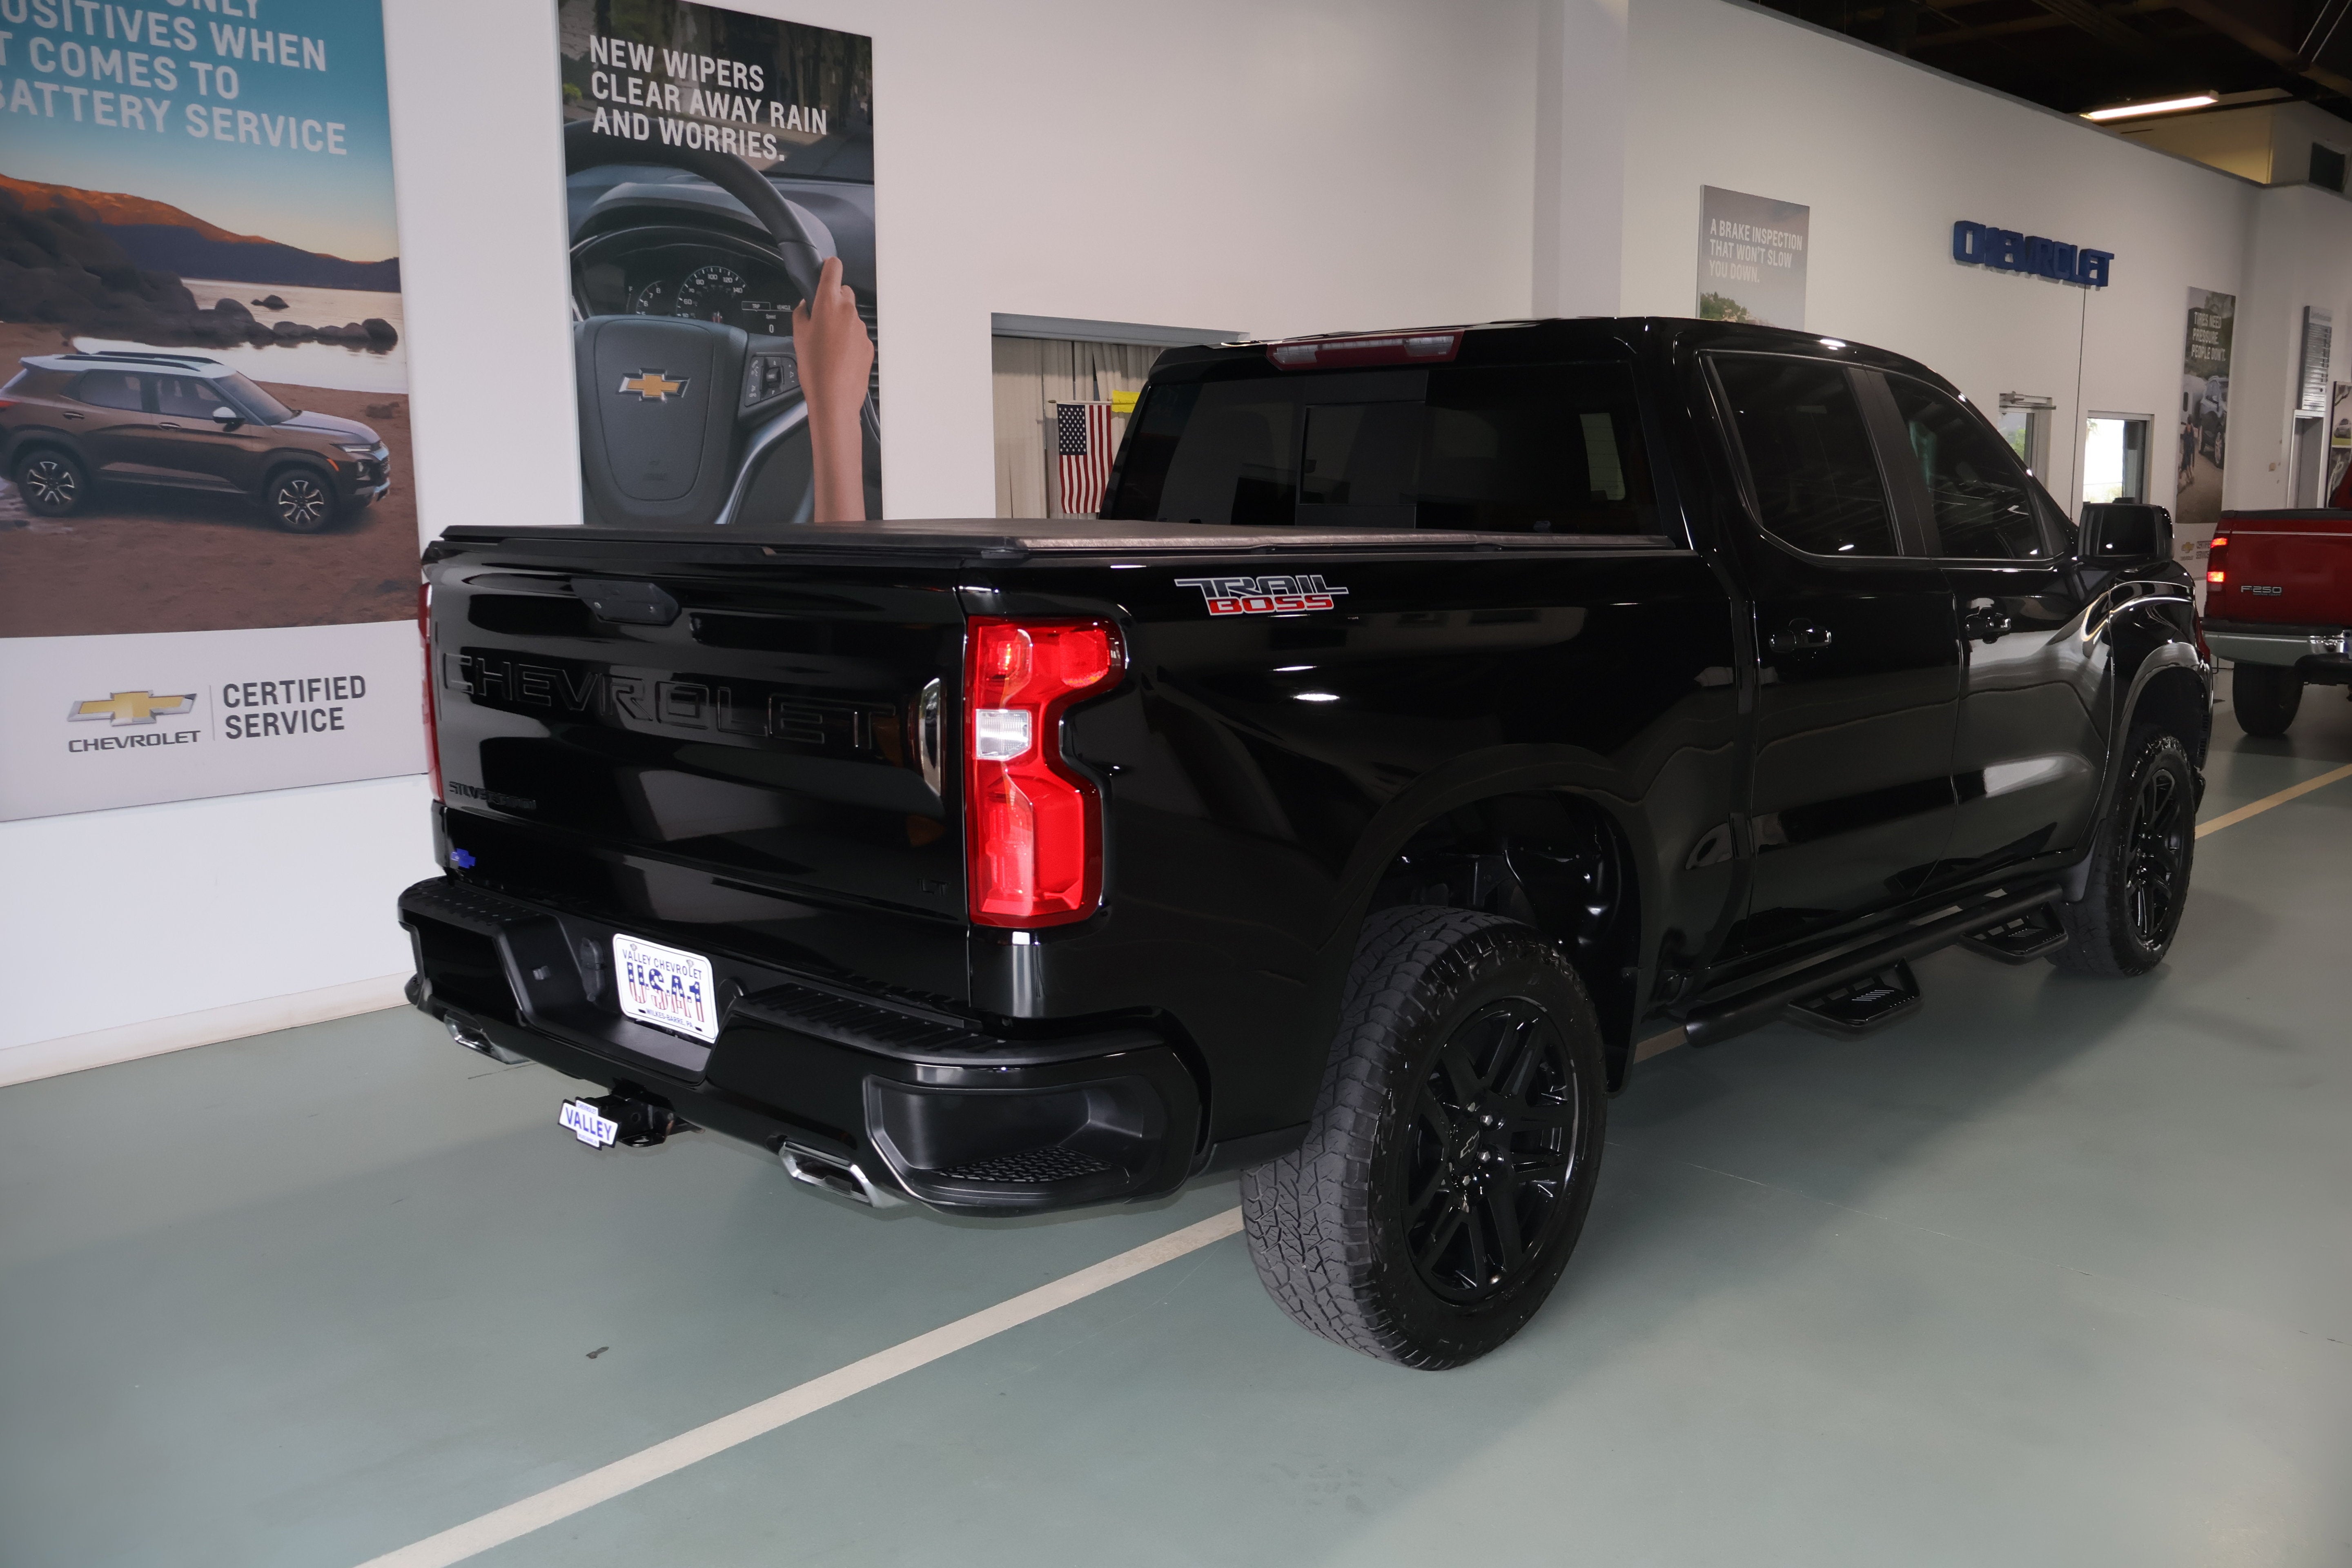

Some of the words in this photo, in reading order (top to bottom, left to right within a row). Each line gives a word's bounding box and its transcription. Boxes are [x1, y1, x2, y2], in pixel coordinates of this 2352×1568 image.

[0, 0, 197, 51] OSITIVES
[209, 22, 326, 71] WHEN
[0, 31, 13, 66] T
[29, 37, 178, 91] COMES
[189, 61, 238, 99] TO
[590, 35, 654, 73] NEW
[662, 49, 764, 92] WIPERS
[0, 78, 170, 132] ATTERY
[186, 104, 347, 155] SERVICE
[591, 71, 681, 113] CLEAR
[690, 89, 762, 124] AWAY
[770, 101, 827, 135] RAIN
[592, 107, 650, 140] AND
[659, 117, 785, 161] WORRIES.
[1710, 218, 1717, 235] A
[1719, 220, 1751, 242] BRAKE
[1752, 226, 1803, 251] INSPECTION
[1710, 239, 1734, 258] THAT
[1737, 244, 1766, 264] WON'T
[1767, 249, 1792, 268] SLOW
[1709, 260, 1728, 278] YOU
[1730, 263, 1760, 283] DOWN.
[1174, 575, 1349, 598] TRAIL
[1206, 594, 1334, 616] BOSS
[223, 675, 366, 708] CERTIFIED
[443, 653, 897, 750] CHEVROLET
[225, 707, 345, 740] SERVICE
[68, 730, 201, 753] CHEVROLET
[622, 949, 651, 965] VALLEY
[653, 958, 702, 980] CHEVROLET
[565, 1107, 612, 1141] VALLEY
